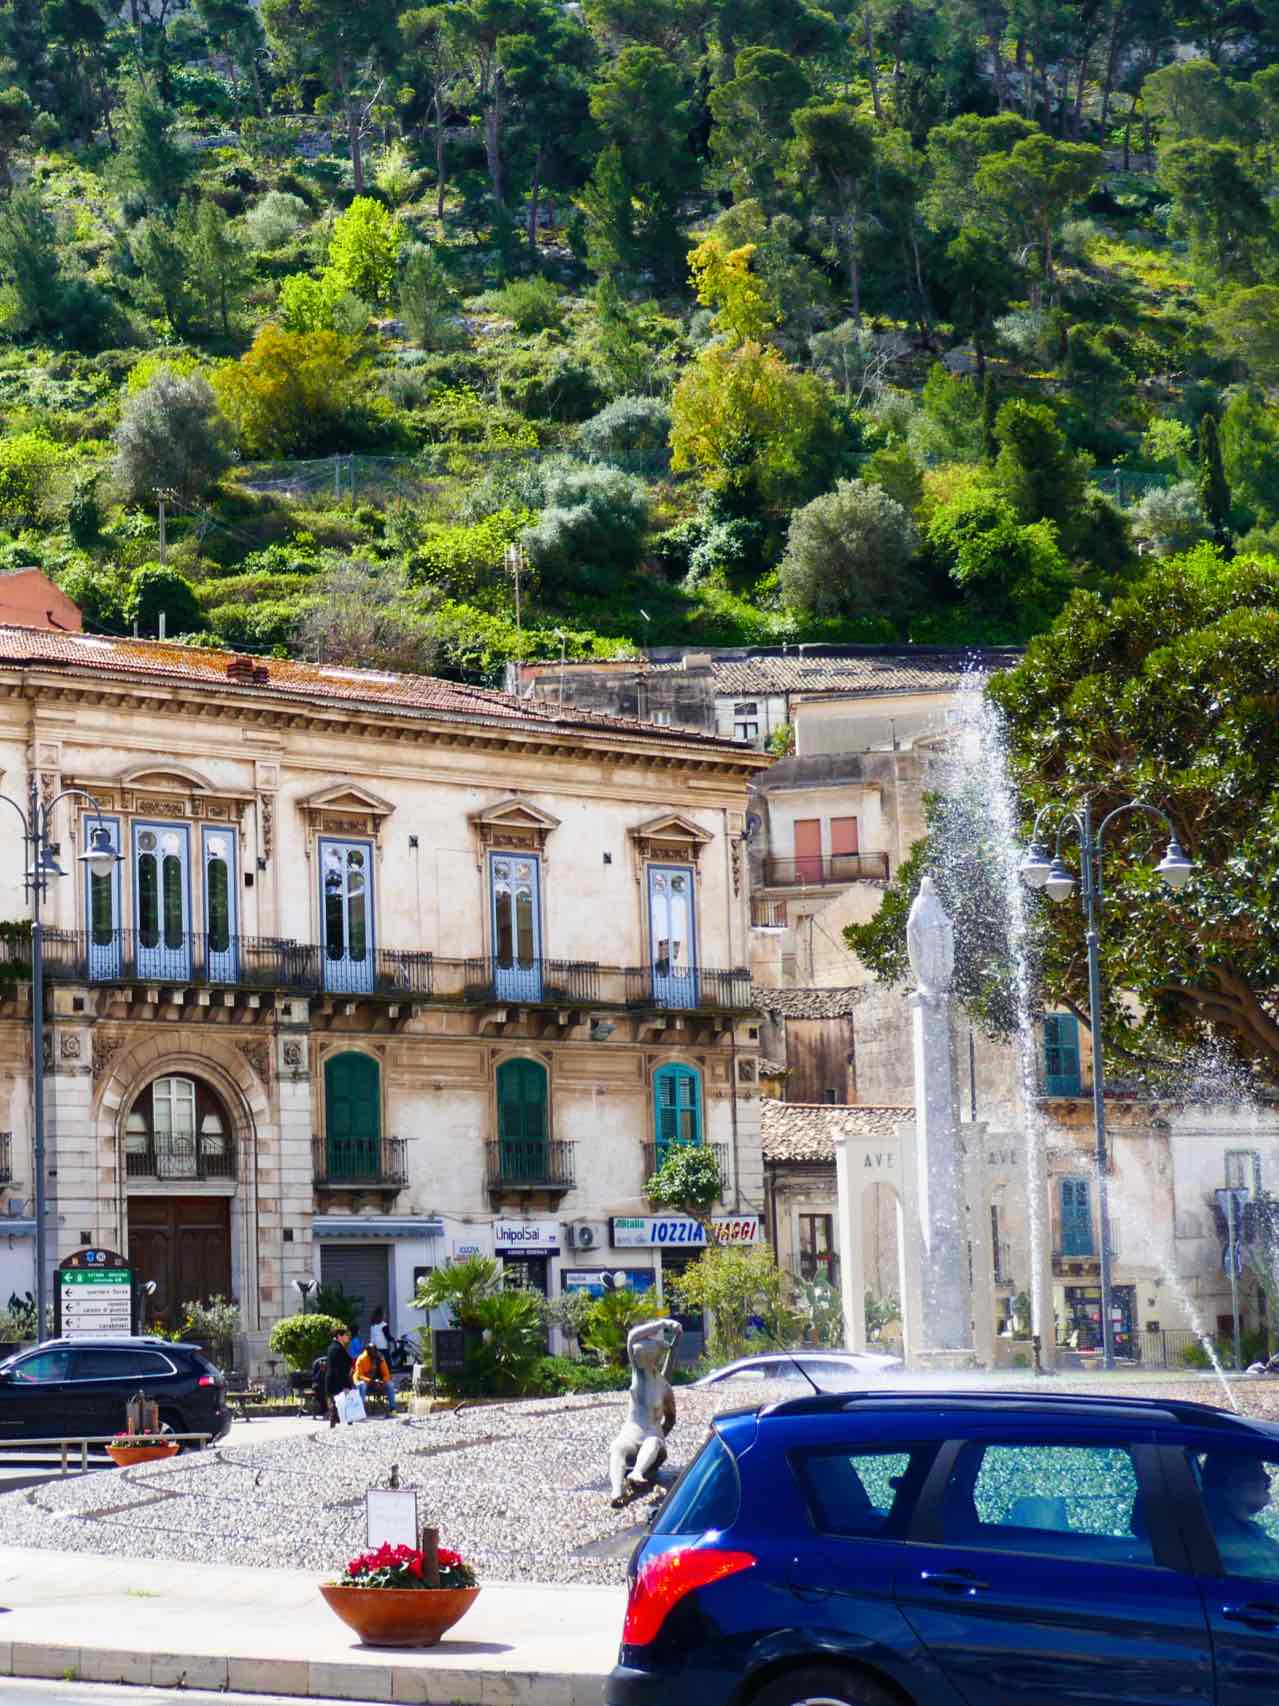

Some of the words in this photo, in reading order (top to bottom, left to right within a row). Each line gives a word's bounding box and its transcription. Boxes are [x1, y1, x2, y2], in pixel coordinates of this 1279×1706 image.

[864, 1153, 893, 1167] AVE
[496, 1225, 540, 1244] UnipolSai
[651, 1223, 704, 1242] IOZZIA
